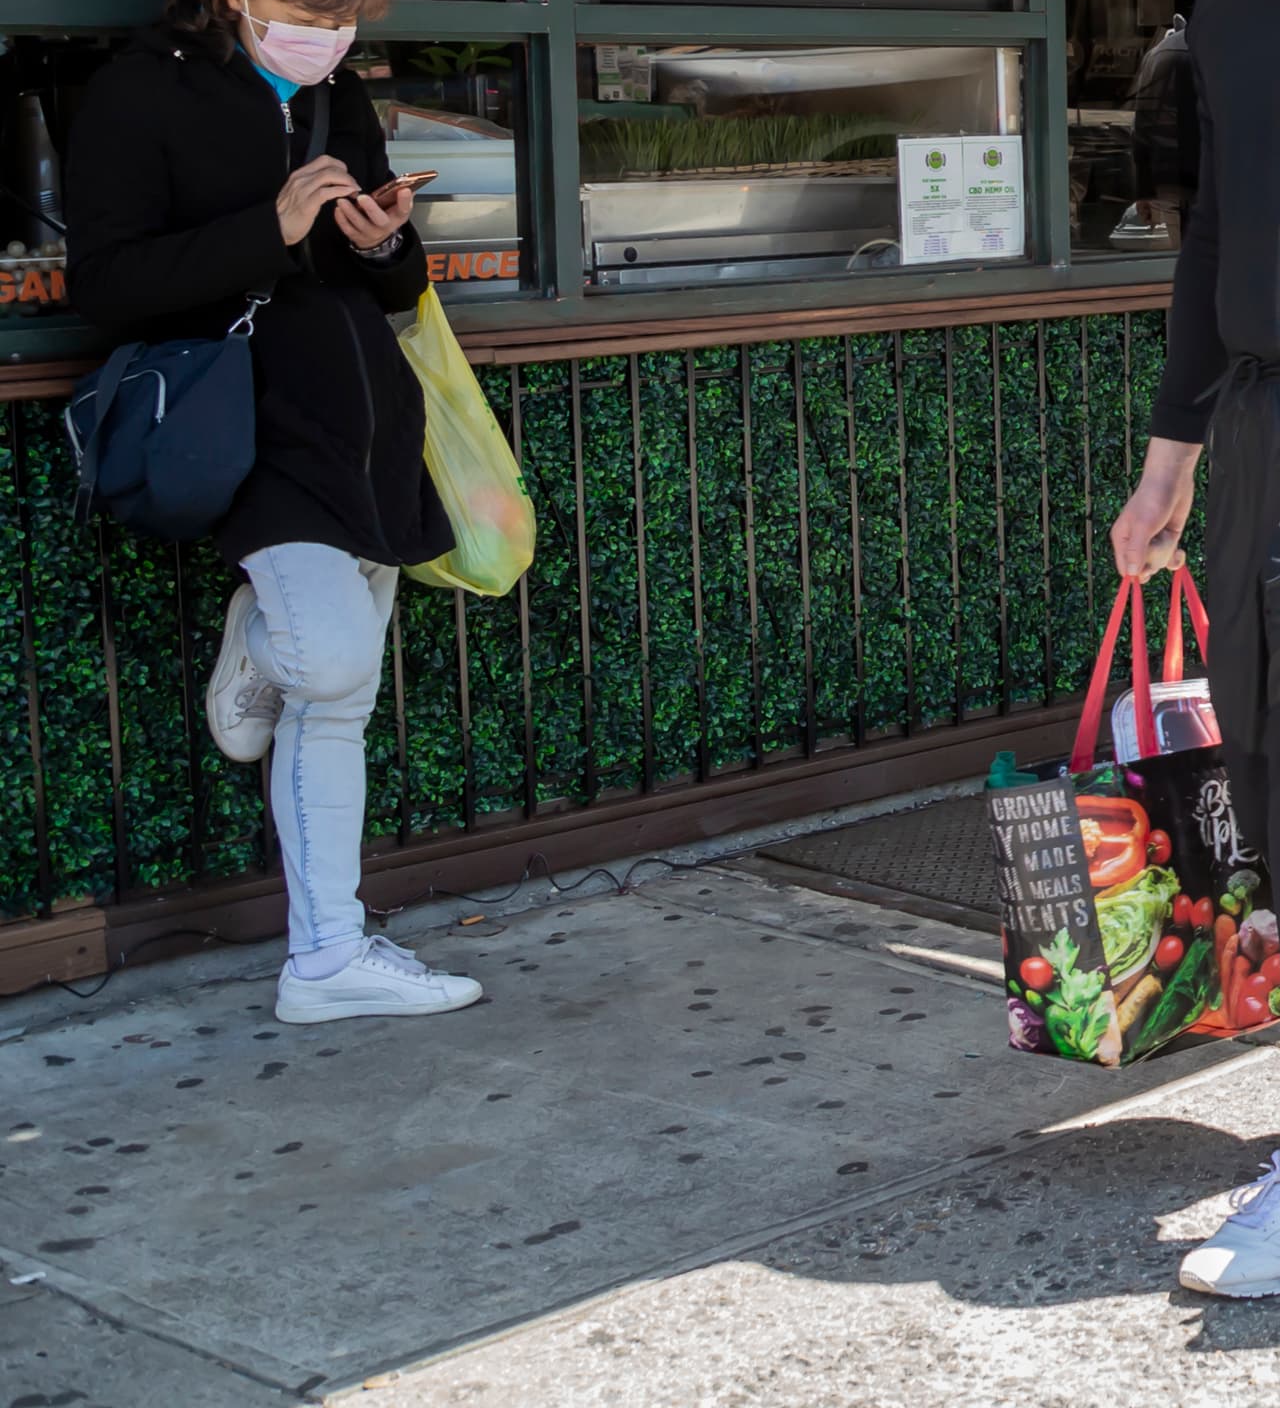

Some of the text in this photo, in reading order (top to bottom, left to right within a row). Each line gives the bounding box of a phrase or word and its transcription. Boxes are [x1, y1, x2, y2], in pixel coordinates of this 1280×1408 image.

[427, 251, 520, 281] ENCE
[992, 789, 1068, 821] GROWN
[1018, 816, 1073, 843] HOME
[1024, 845, 1077, 871] MADE
[1029, 874, 1083, 900] MEALS
